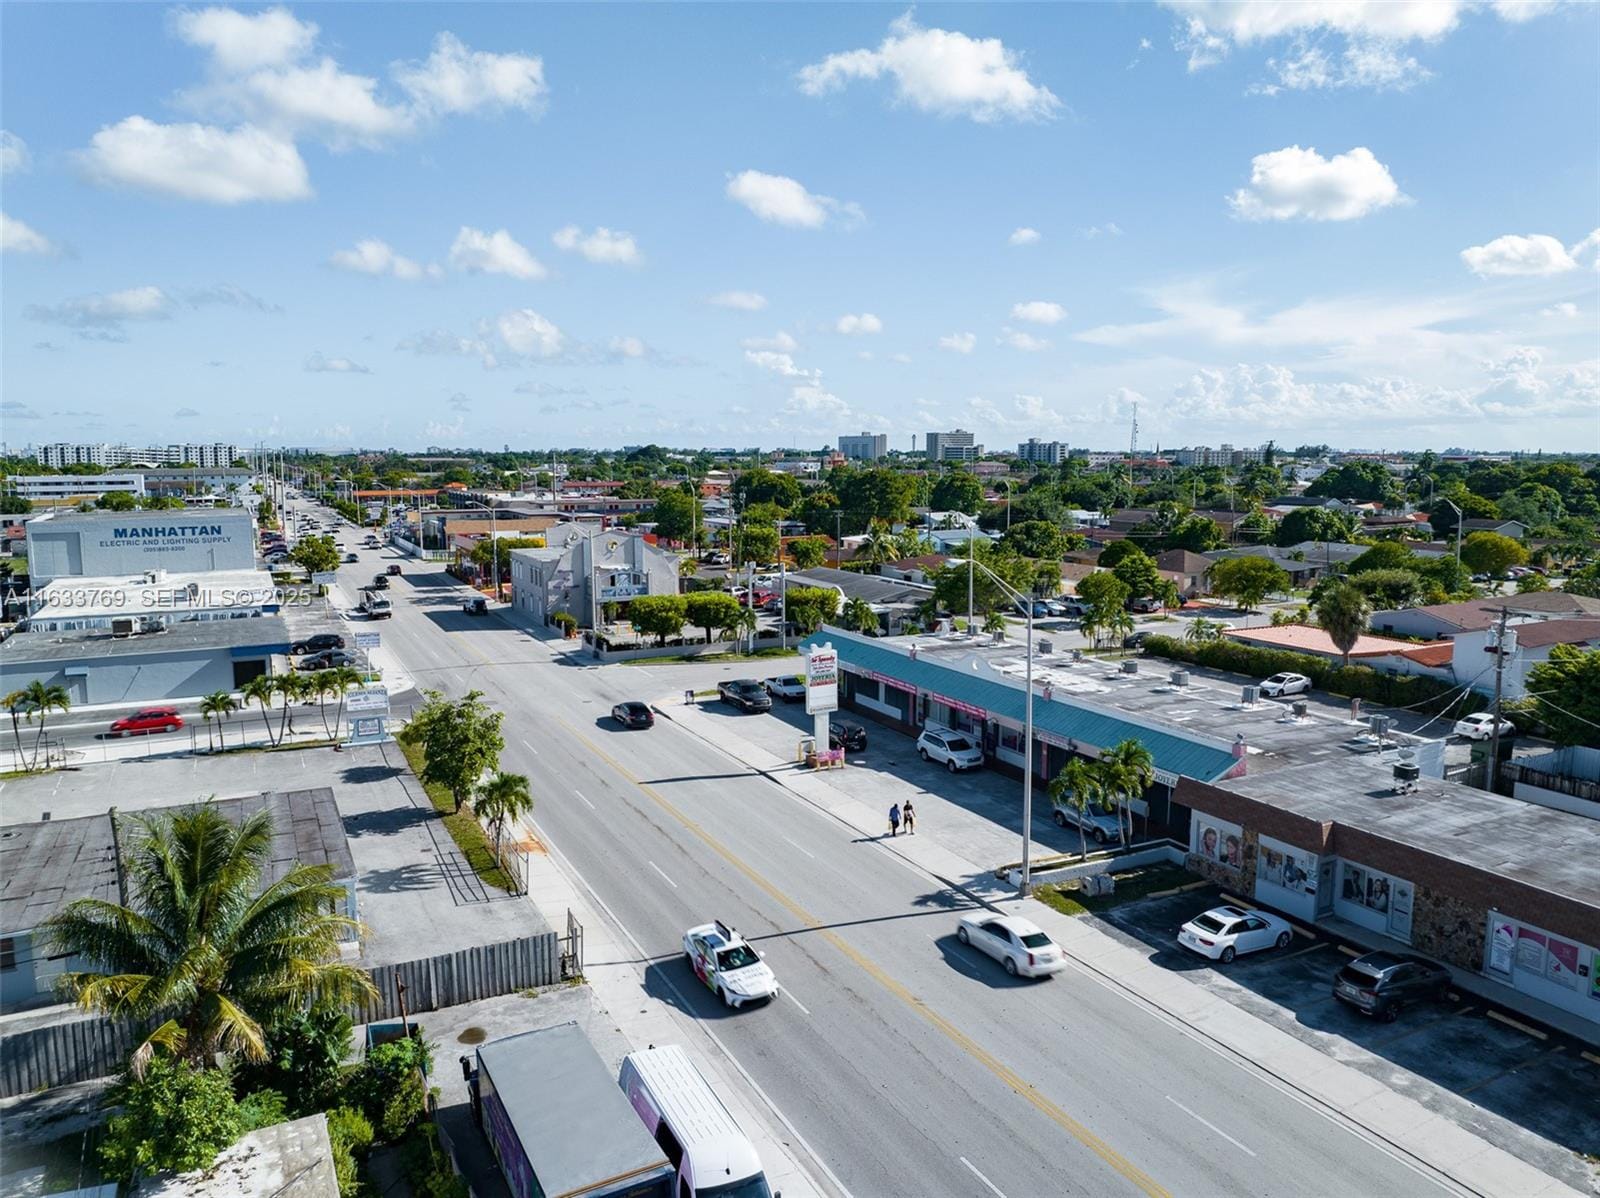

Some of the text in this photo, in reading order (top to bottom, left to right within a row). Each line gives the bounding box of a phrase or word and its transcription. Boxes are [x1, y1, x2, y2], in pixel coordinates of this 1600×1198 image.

[113, 525, 222, 538] MANHATTAN
[99, 536, 232, 548] ELECTRIC AND LIGHTING SUPPLY
